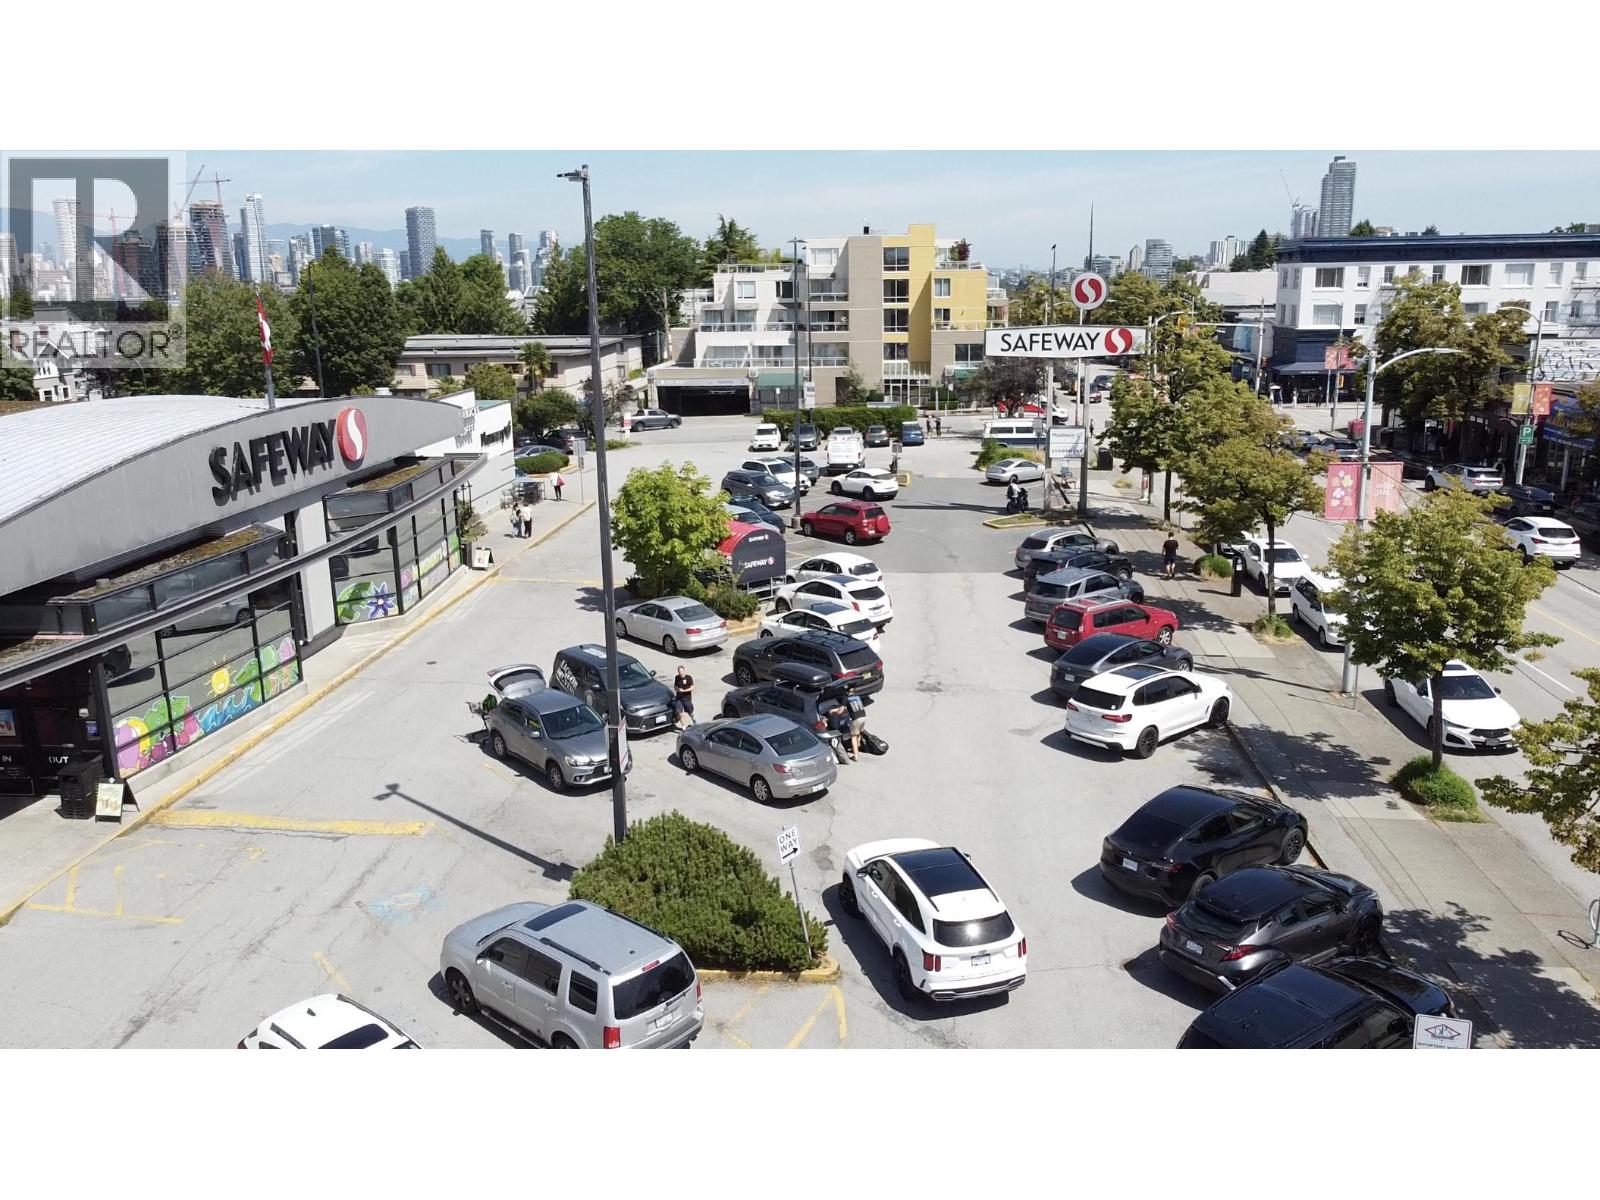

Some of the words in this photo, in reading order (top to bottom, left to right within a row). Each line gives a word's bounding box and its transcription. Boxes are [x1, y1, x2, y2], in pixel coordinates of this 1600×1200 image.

[1000, 332, 1100, 352] SAFEWAY
[1522, 426, 1532, 436] P
[208, 419, 336, 506] SAFEWAY
[744, 559, 767, 569] SAFEWAY
[48, 756, 69, 764] OUT
[779, 830, 796, 844] ONE
[780, 837, 798, 853] WAY
